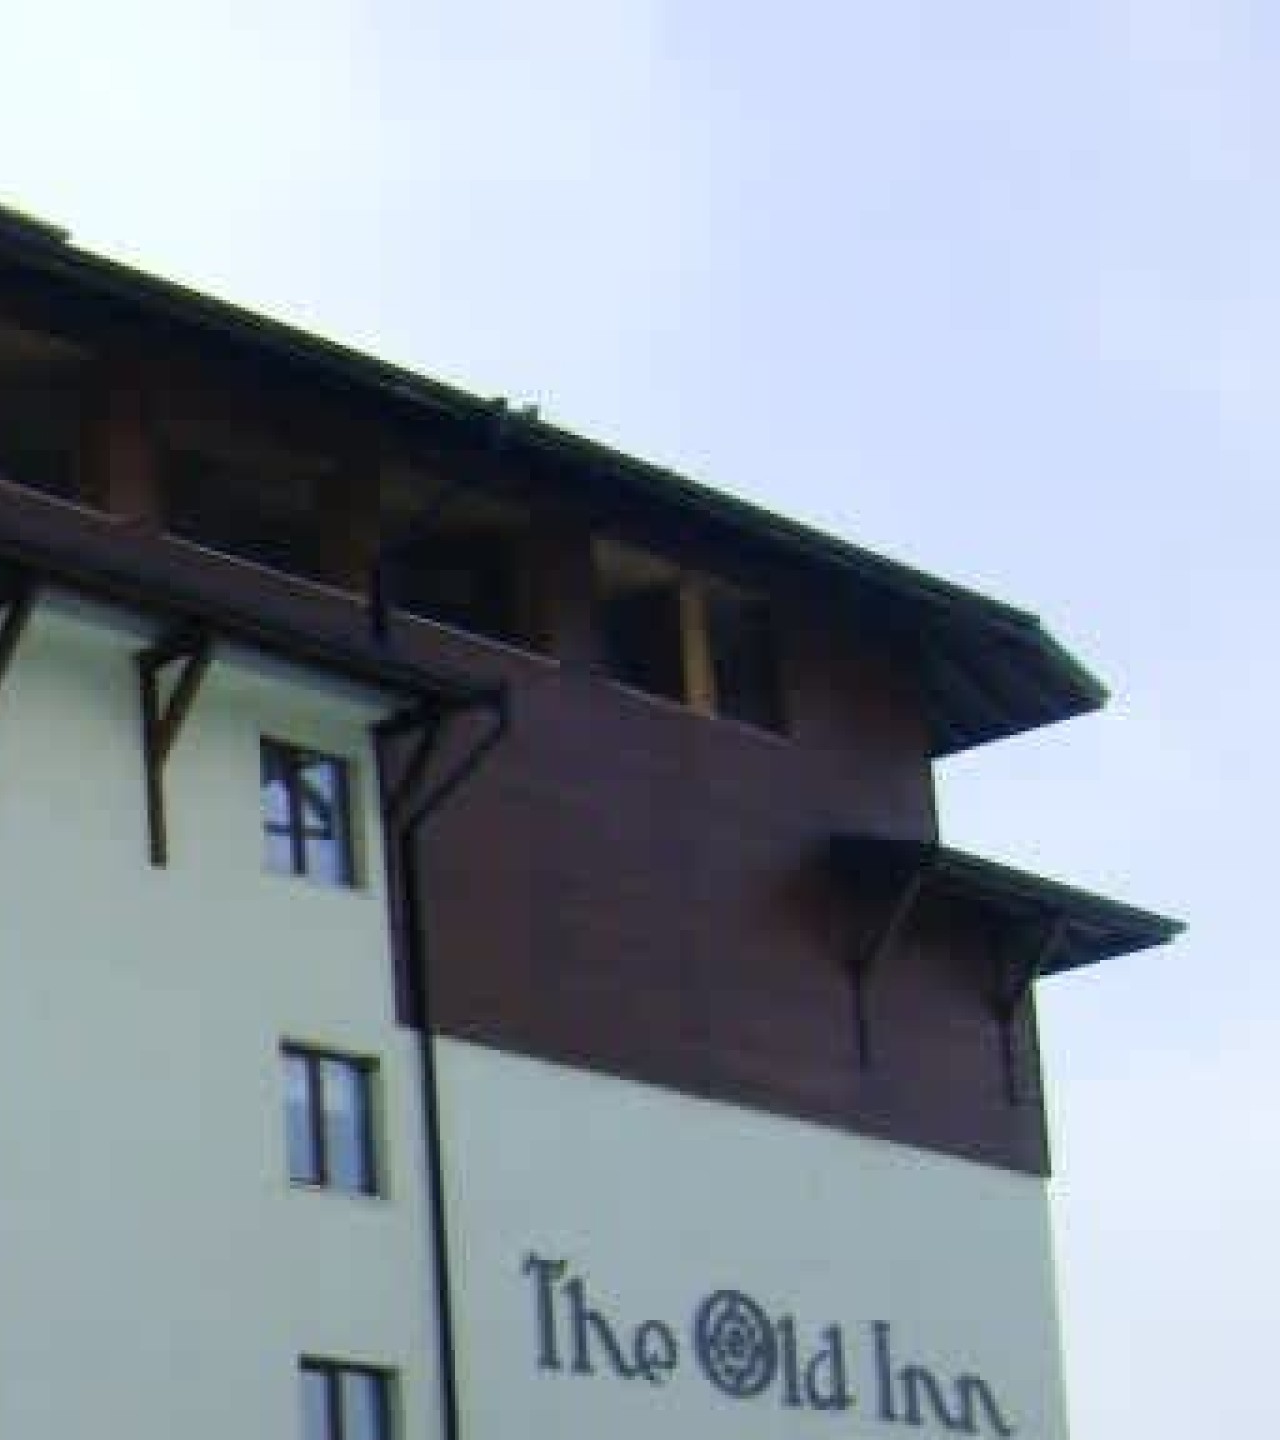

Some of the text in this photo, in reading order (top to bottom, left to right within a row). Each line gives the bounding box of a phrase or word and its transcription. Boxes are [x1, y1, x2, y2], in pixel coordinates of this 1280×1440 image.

[522, 1250, 1016, 1439] The Old Inn
